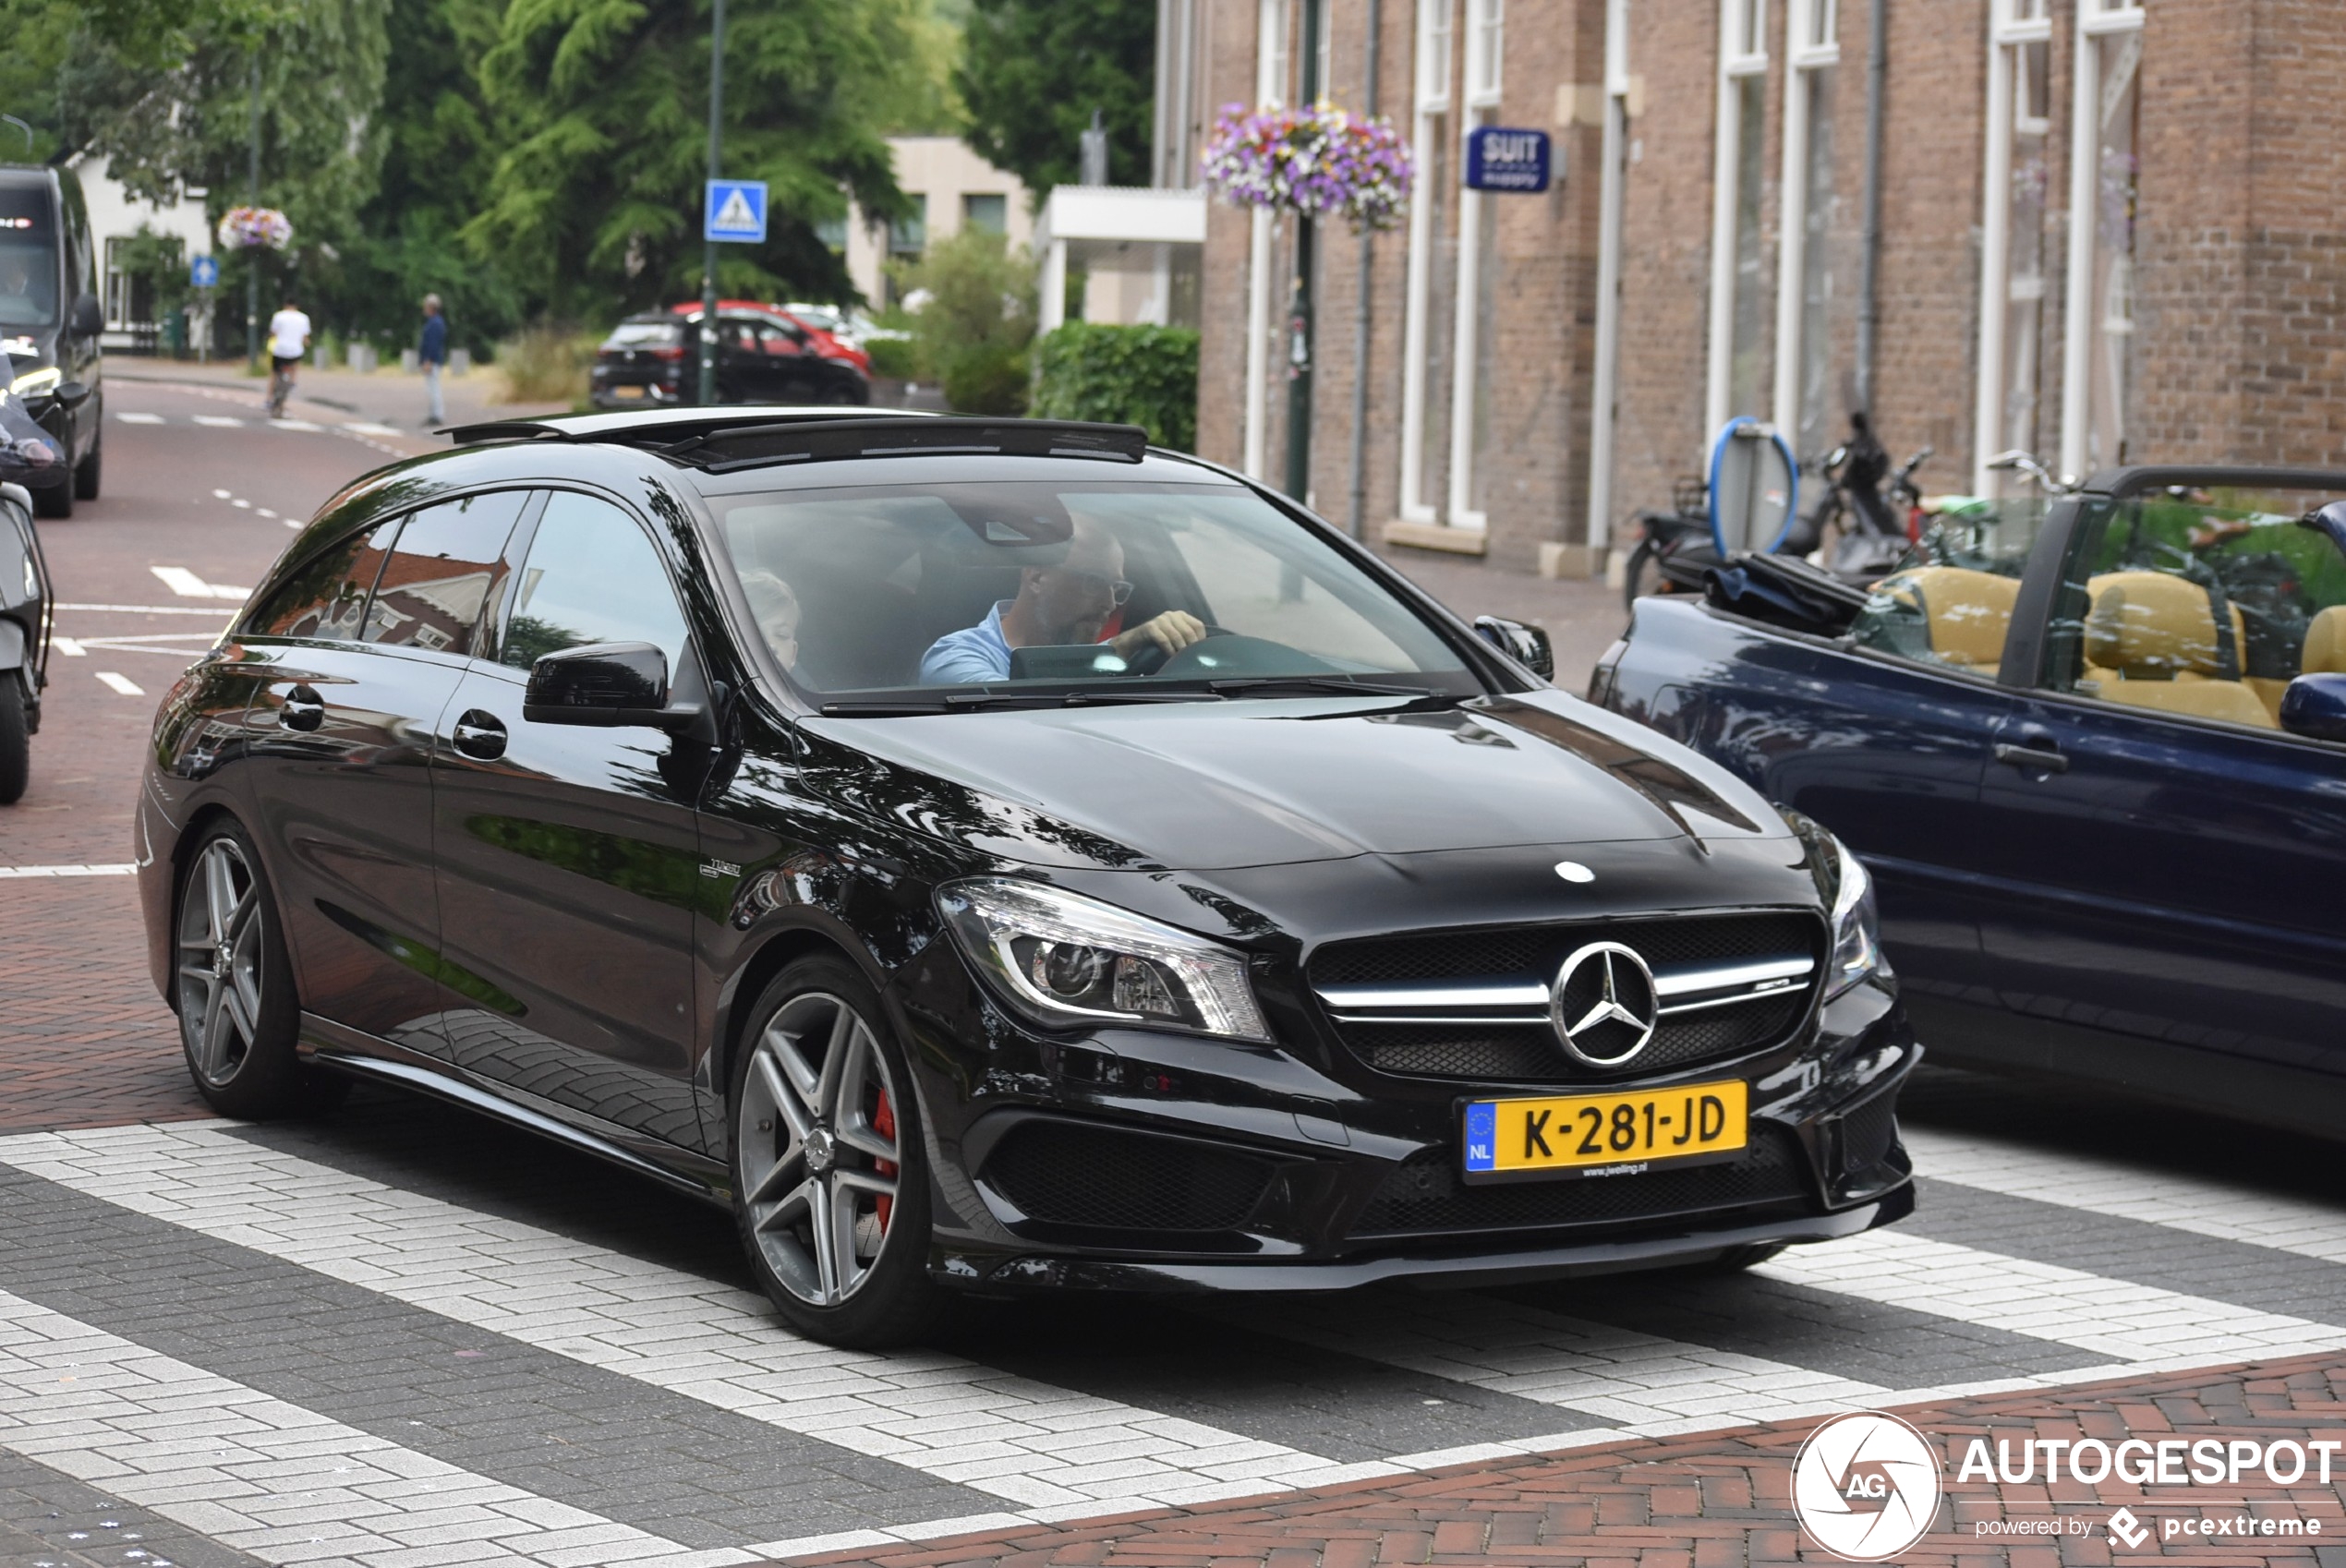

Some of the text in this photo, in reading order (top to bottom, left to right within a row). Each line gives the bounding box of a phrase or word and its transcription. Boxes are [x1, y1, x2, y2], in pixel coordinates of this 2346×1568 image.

[1481, 132, 1542, 163] SUIT
[1469, 1094, 1725, 1160] NL K-281-JD
